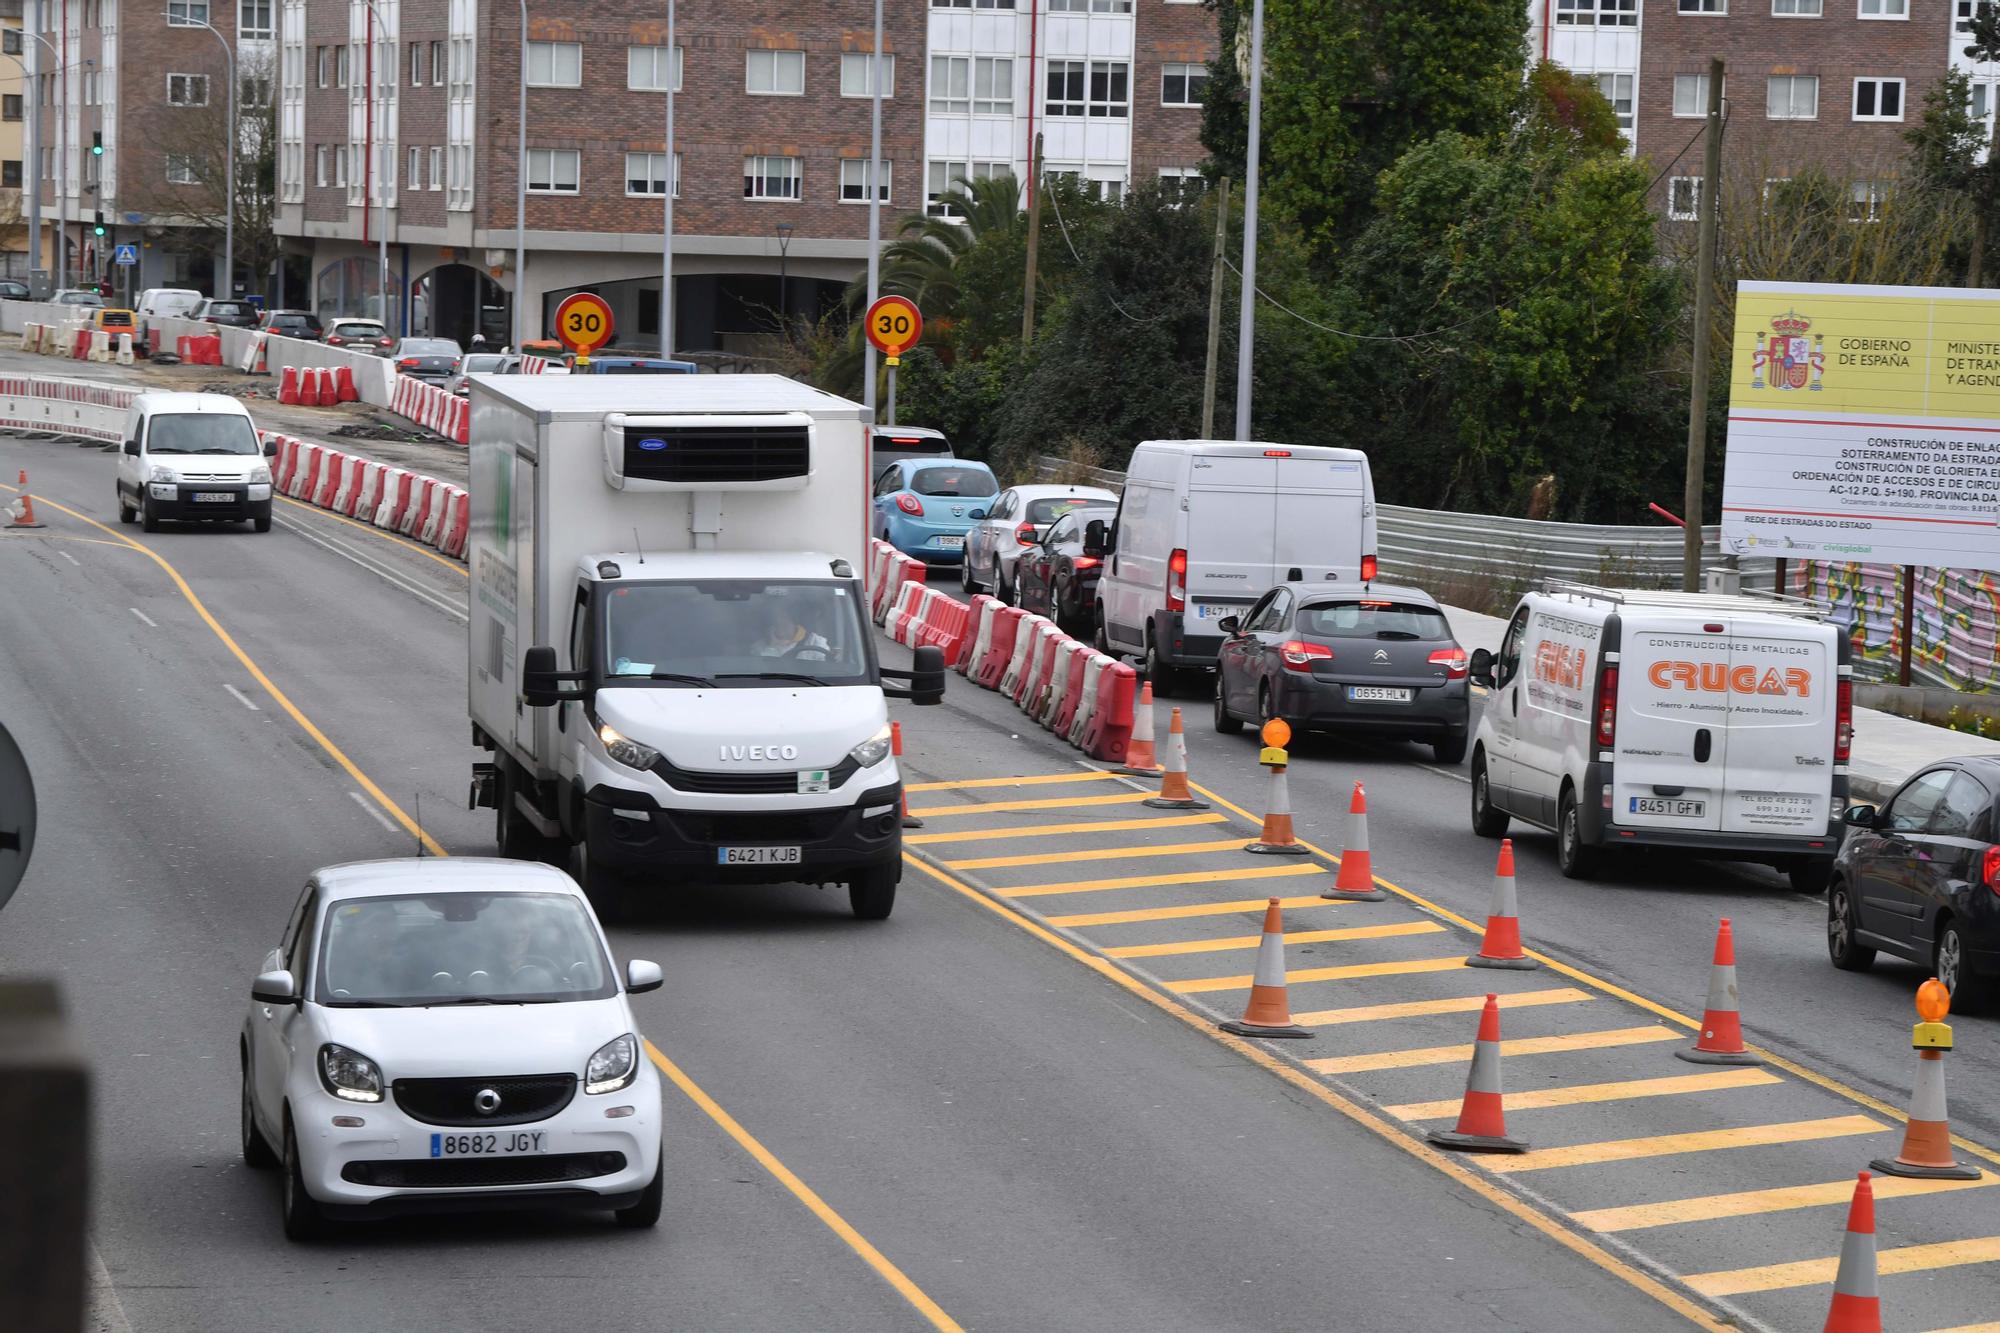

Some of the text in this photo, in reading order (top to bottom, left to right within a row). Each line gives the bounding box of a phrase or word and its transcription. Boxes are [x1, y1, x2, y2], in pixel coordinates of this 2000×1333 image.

[569, 313, 600, 332] 30
[879, 315, 909, 334] 30
[1840, 338, 1911, 352] GOBIERNO
[1947, 342, 2000, 355] MINISTE
[1839, 353, 1910, 367] DE ESPAÑA
[1946, 358, 1964, 369] DE
[1946, 373, 1954, 385] Y
[1867, 437, 1945, 450] CONSTRUCIÓN
[1949, 441, 1963, 451] DE
[1841, 449, 2000, 465] SOTERRAMENTO DA ESTRADA
[1835, 461, 1913, 473] CONSTRUCIÓN
[1916, 465, 1930, 474] DE
[1933, 466, 1988, 477] GLORIETA
[1792, 471, 2000, 490] ORDENACIÓN DE ACCESOS E DE CIRCU
[1829, 485, 1998, 503] AC-12 P.Q. 5+190. PROVINCIA DA
[1744, 515, 1872, 530] REDE DE ESTRADAS DO ESTADO
[1649, 639, 1809, 656] CONSTRUCCIONES METALICAS
[1648, 660, 1811, 697] CRUGAR
[1689, 703, 1726, 712] Aluminio
[1735, 706, 1760, 714] Acero
[1761, 708, 1803, 716] Inoxidable
[719, 745, 798, 761] IVECO
[1795, 756, 1825, 766] Trafic
[1640, 800, 1672, 813] 8451
[728, 848, 798, 862] 6421 KJB
[445, 1132, 542, 1154] 8682 JGY
